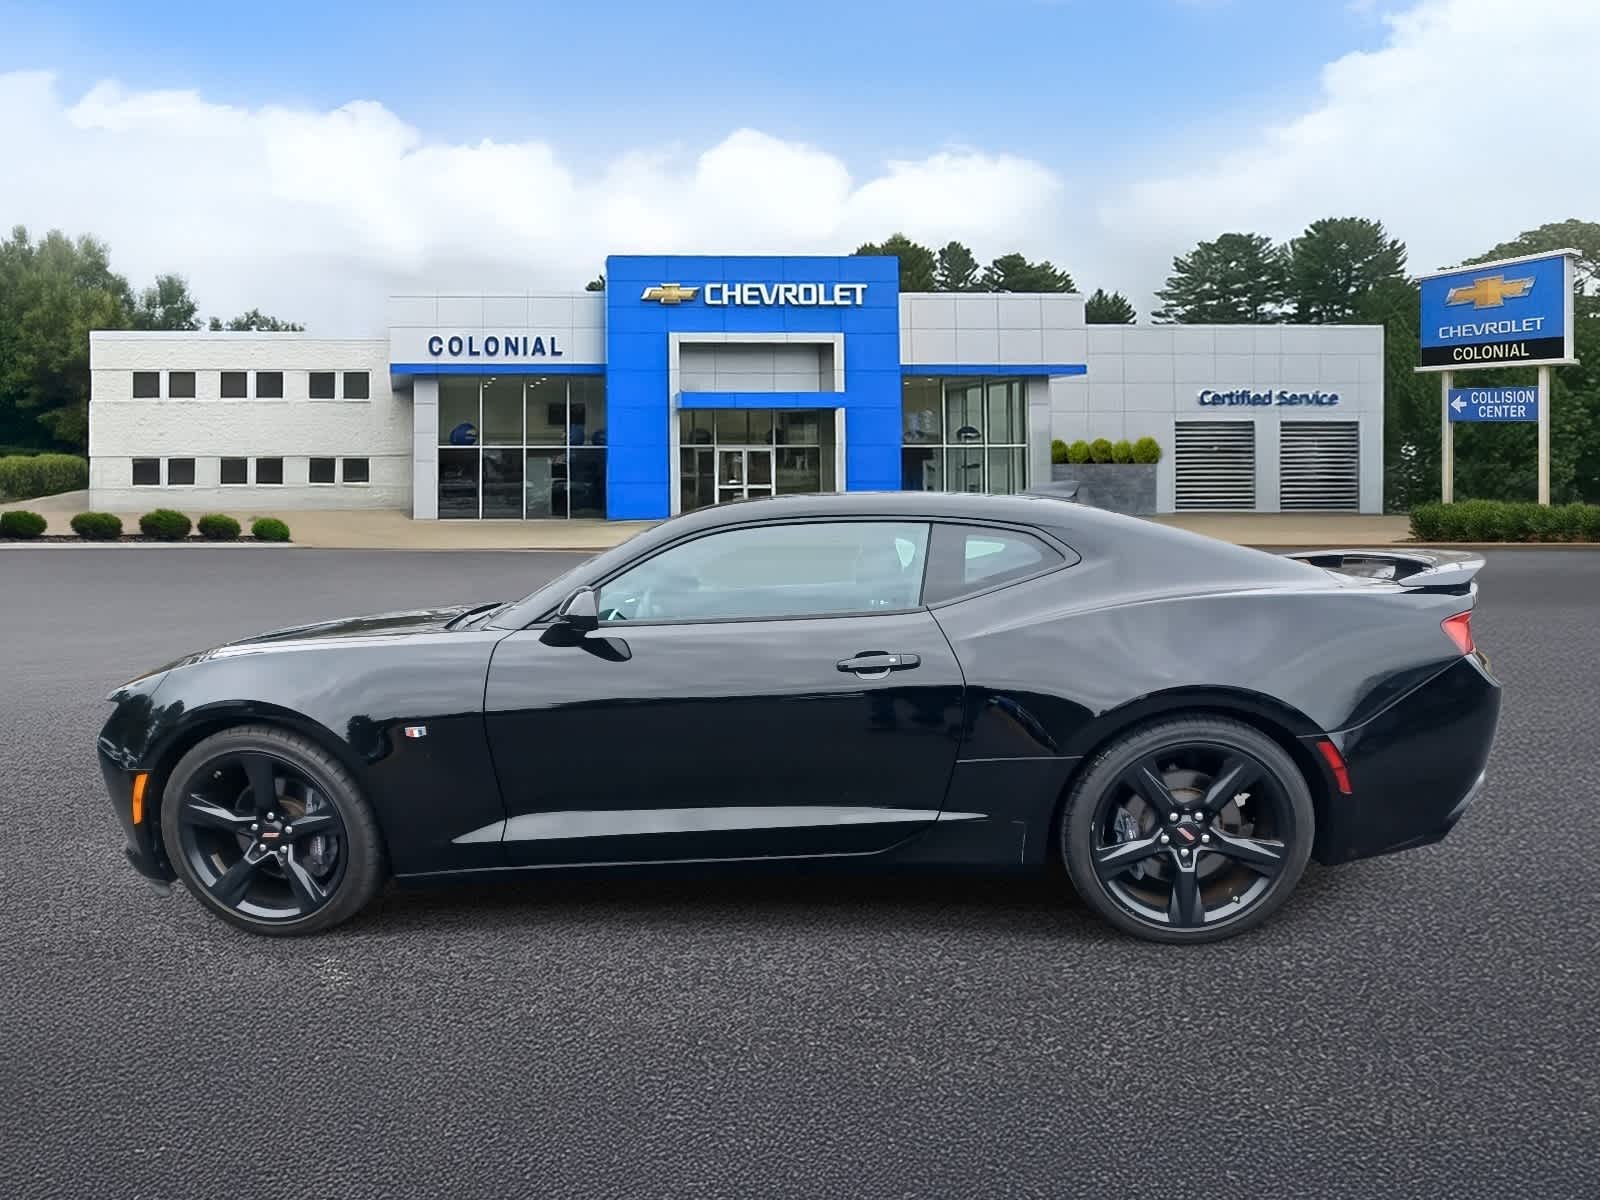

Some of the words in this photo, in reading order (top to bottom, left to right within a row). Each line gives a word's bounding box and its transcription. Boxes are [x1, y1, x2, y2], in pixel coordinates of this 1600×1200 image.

[704, 282, 869, 306] CHEVROLET
[1438, 317, 1545, 339] CHEVROLET
[428, 335, 563, 357] COLONIAL
[1453, 343, 1530, 361] COLONIAL
[1199, 389, 1273, 406] Certified
[1276, 390, 1340, 406] Service
[1471, 390, 1535, 404] COLLISION
[1478, 405, 1526, 418] CENTER
